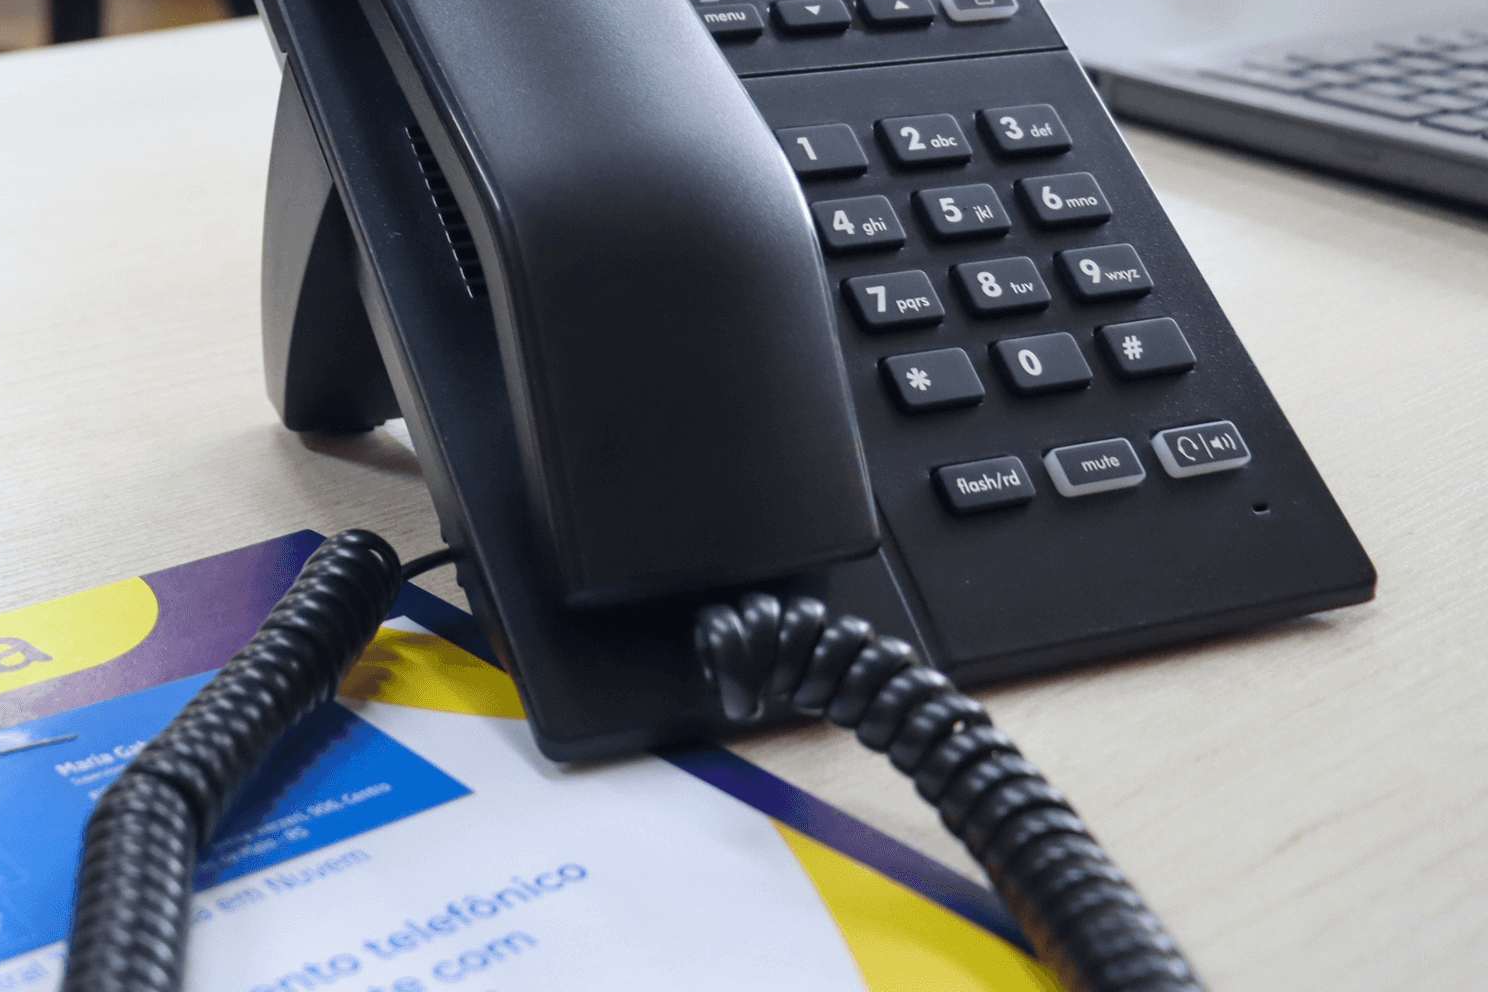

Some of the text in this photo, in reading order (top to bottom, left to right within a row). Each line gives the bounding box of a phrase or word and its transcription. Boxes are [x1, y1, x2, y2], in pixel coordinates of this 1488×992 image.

[703, 11, 747, 24] menu
[899, 126, 958, 151] 2 abc
[999, 116, 1054, 140] 3 def
[796, 136, 818, 161] 1
[938, 197, 995, 223] 5 jkl
[1041, 185, 1098, 210] 6 mno
[832, 209, 888, 236] 4 ghi
[1078, 258, 1141, 284] 9 wxyz
[976, 271, 1035, 298] 8 tuv
[865, 285, 931, 314] 7 pqrs
[1017, 348, 1043, 376] 0
[1080, 454, 1121, 473] mute
[956, 469, 1021, 496] flash/rd
[54, 753, 116, 778] Maria
[362, 862, 589, 960] telefônico
[431, 931, 539, 985] com
